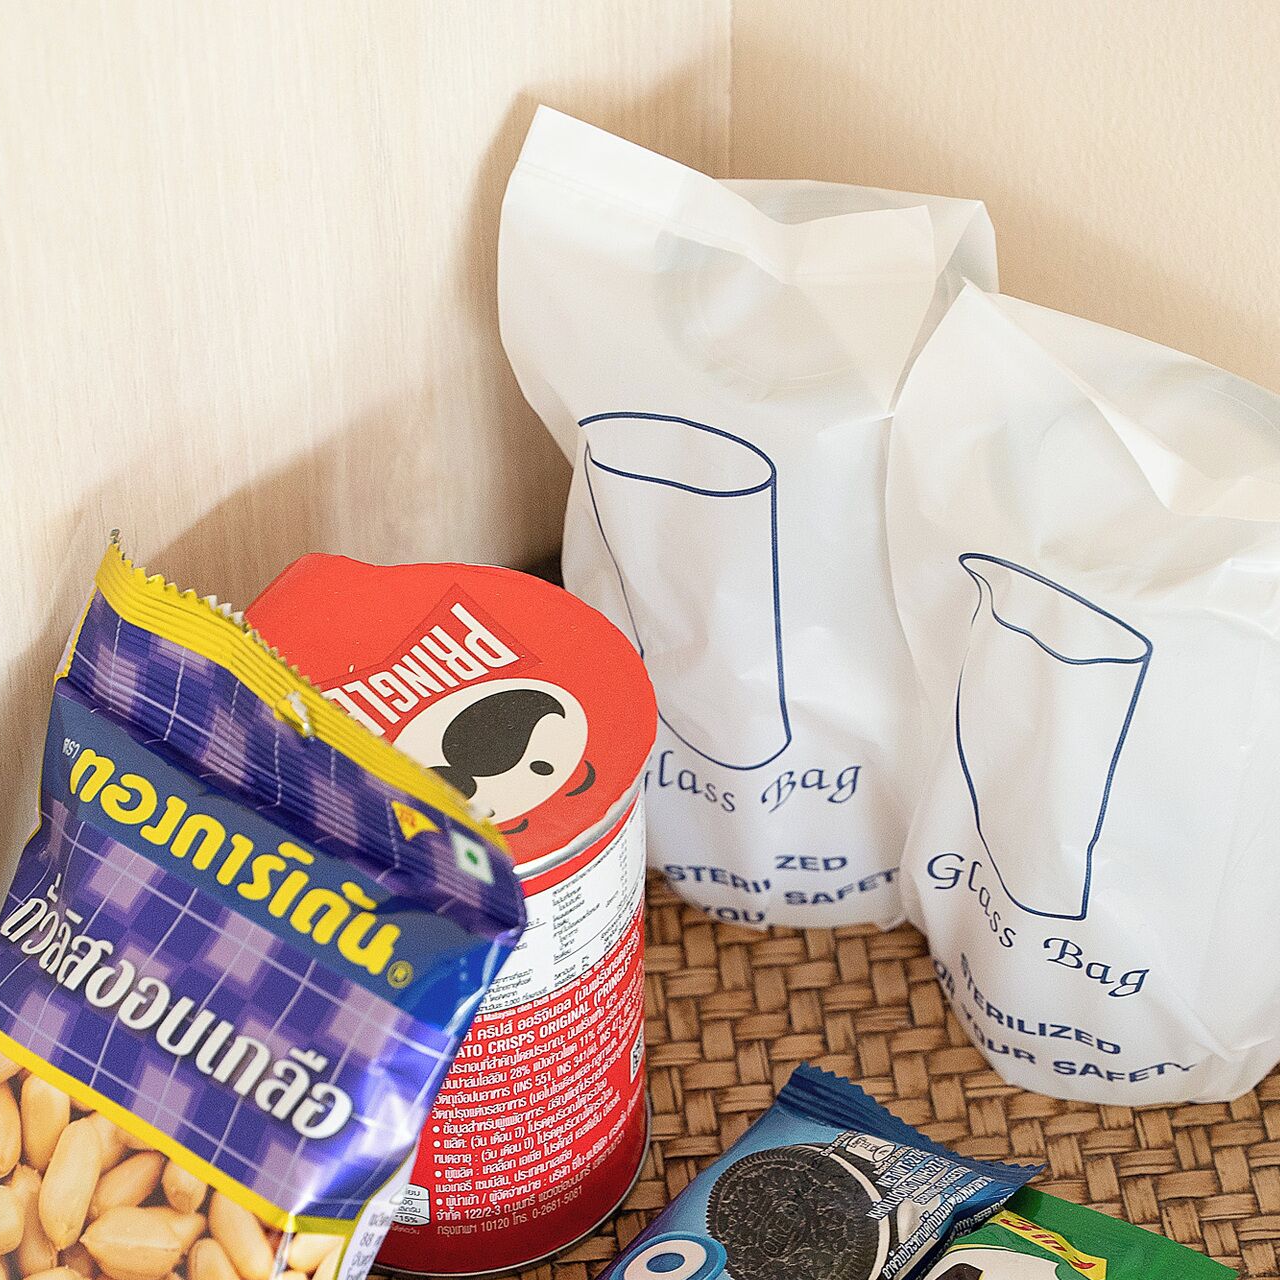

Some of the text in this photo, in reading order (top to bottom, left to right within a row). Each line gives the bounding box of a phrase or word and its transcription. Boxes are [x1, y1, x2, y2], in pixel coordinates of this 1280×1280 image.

[319, 602, 520, 736] PRINGLE
[644, 751, 862, 812] lass Bag
[927, 852, 1150, 997] Glass Bag
[0, 872, 352, 1139] ถั่วลิสงอบเกลือ
[961, 952, 1121, 1055] STERILIZED
[488, 1005, 591, 1055] CRISPS ORIGINAL
[511, 1063, 530, 1080] 28%
[513, 1078, 533, 1096] (INS
[1053, 1060, 1196, 1082] SAFETY
[464, 1206, 501, 1219] 122/2-3
[481, 1219, 509, 1233] 10120
[532, 1186, 583, 1218] 0-2681-5081
[1000, 1218, 1033, 1232] 3
